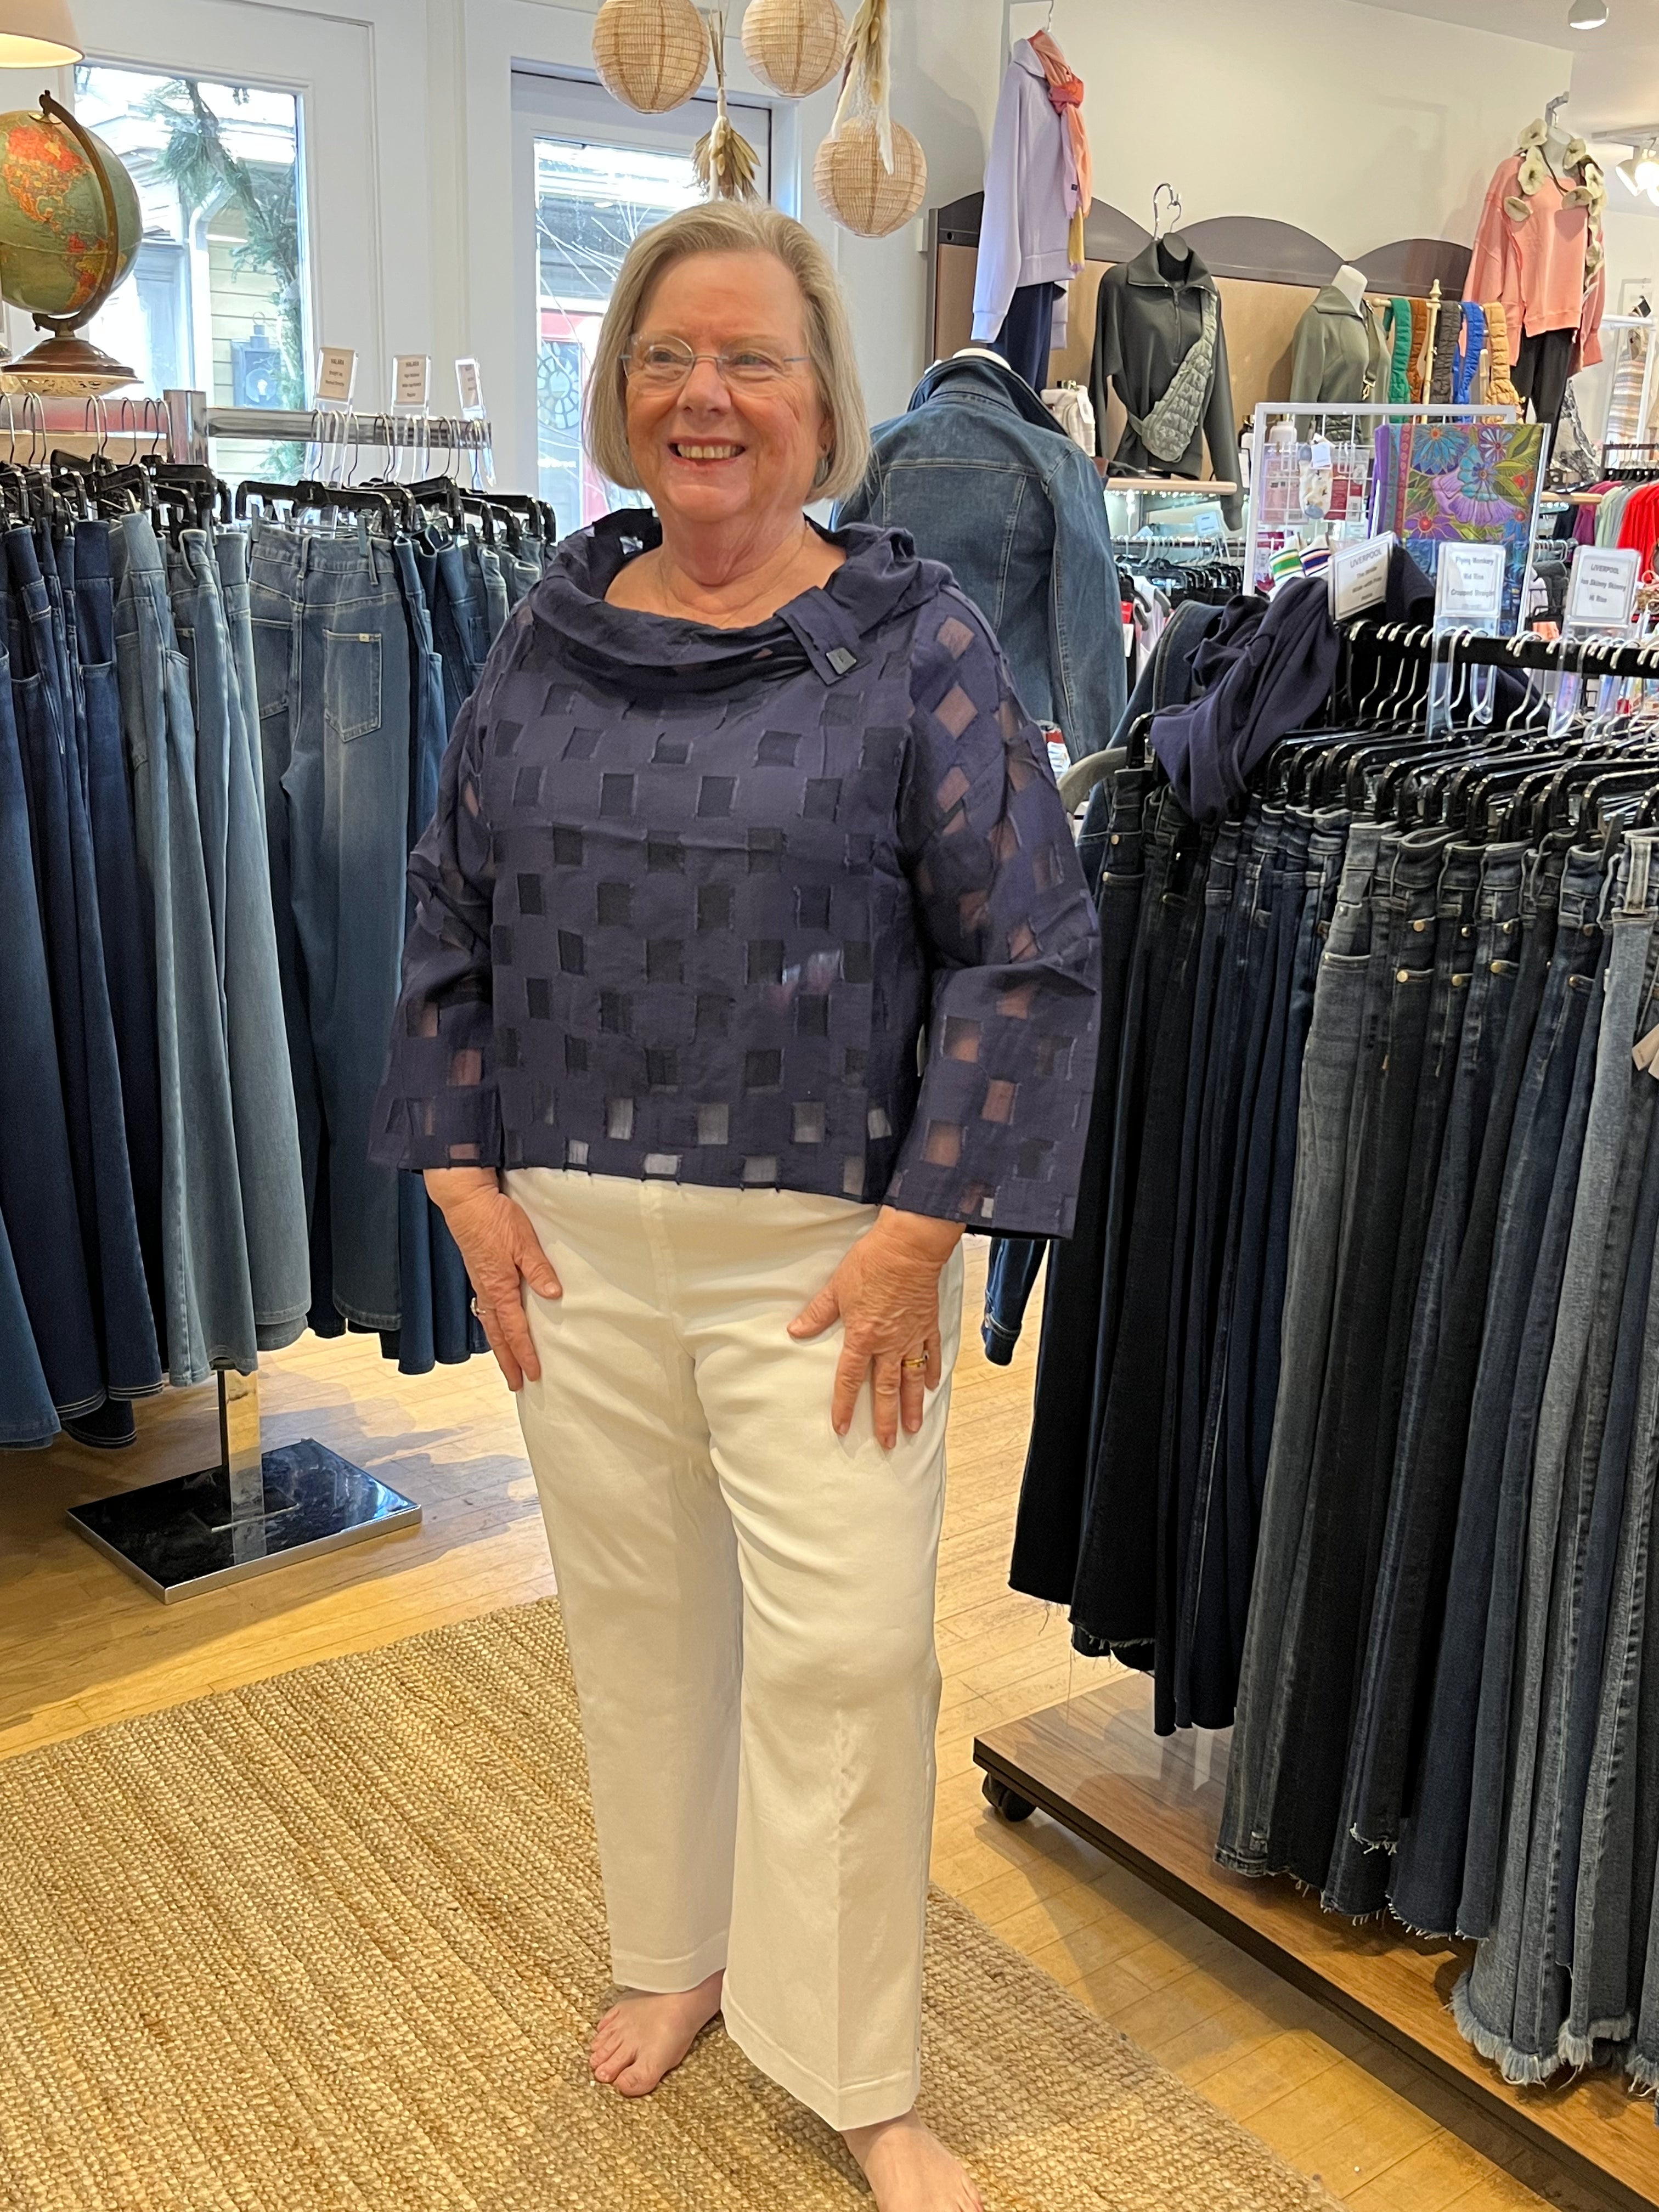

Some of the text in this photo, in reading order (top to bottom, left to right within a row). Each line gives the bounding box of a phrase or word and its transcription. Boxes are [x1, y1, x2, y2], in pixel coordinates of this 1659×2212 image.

[1350, 548, 1382, 568] LIVERPOOL
[1455, 556, 1471, 566] Flying
[1591, 563, 1619, 574] LIVERPOOL
